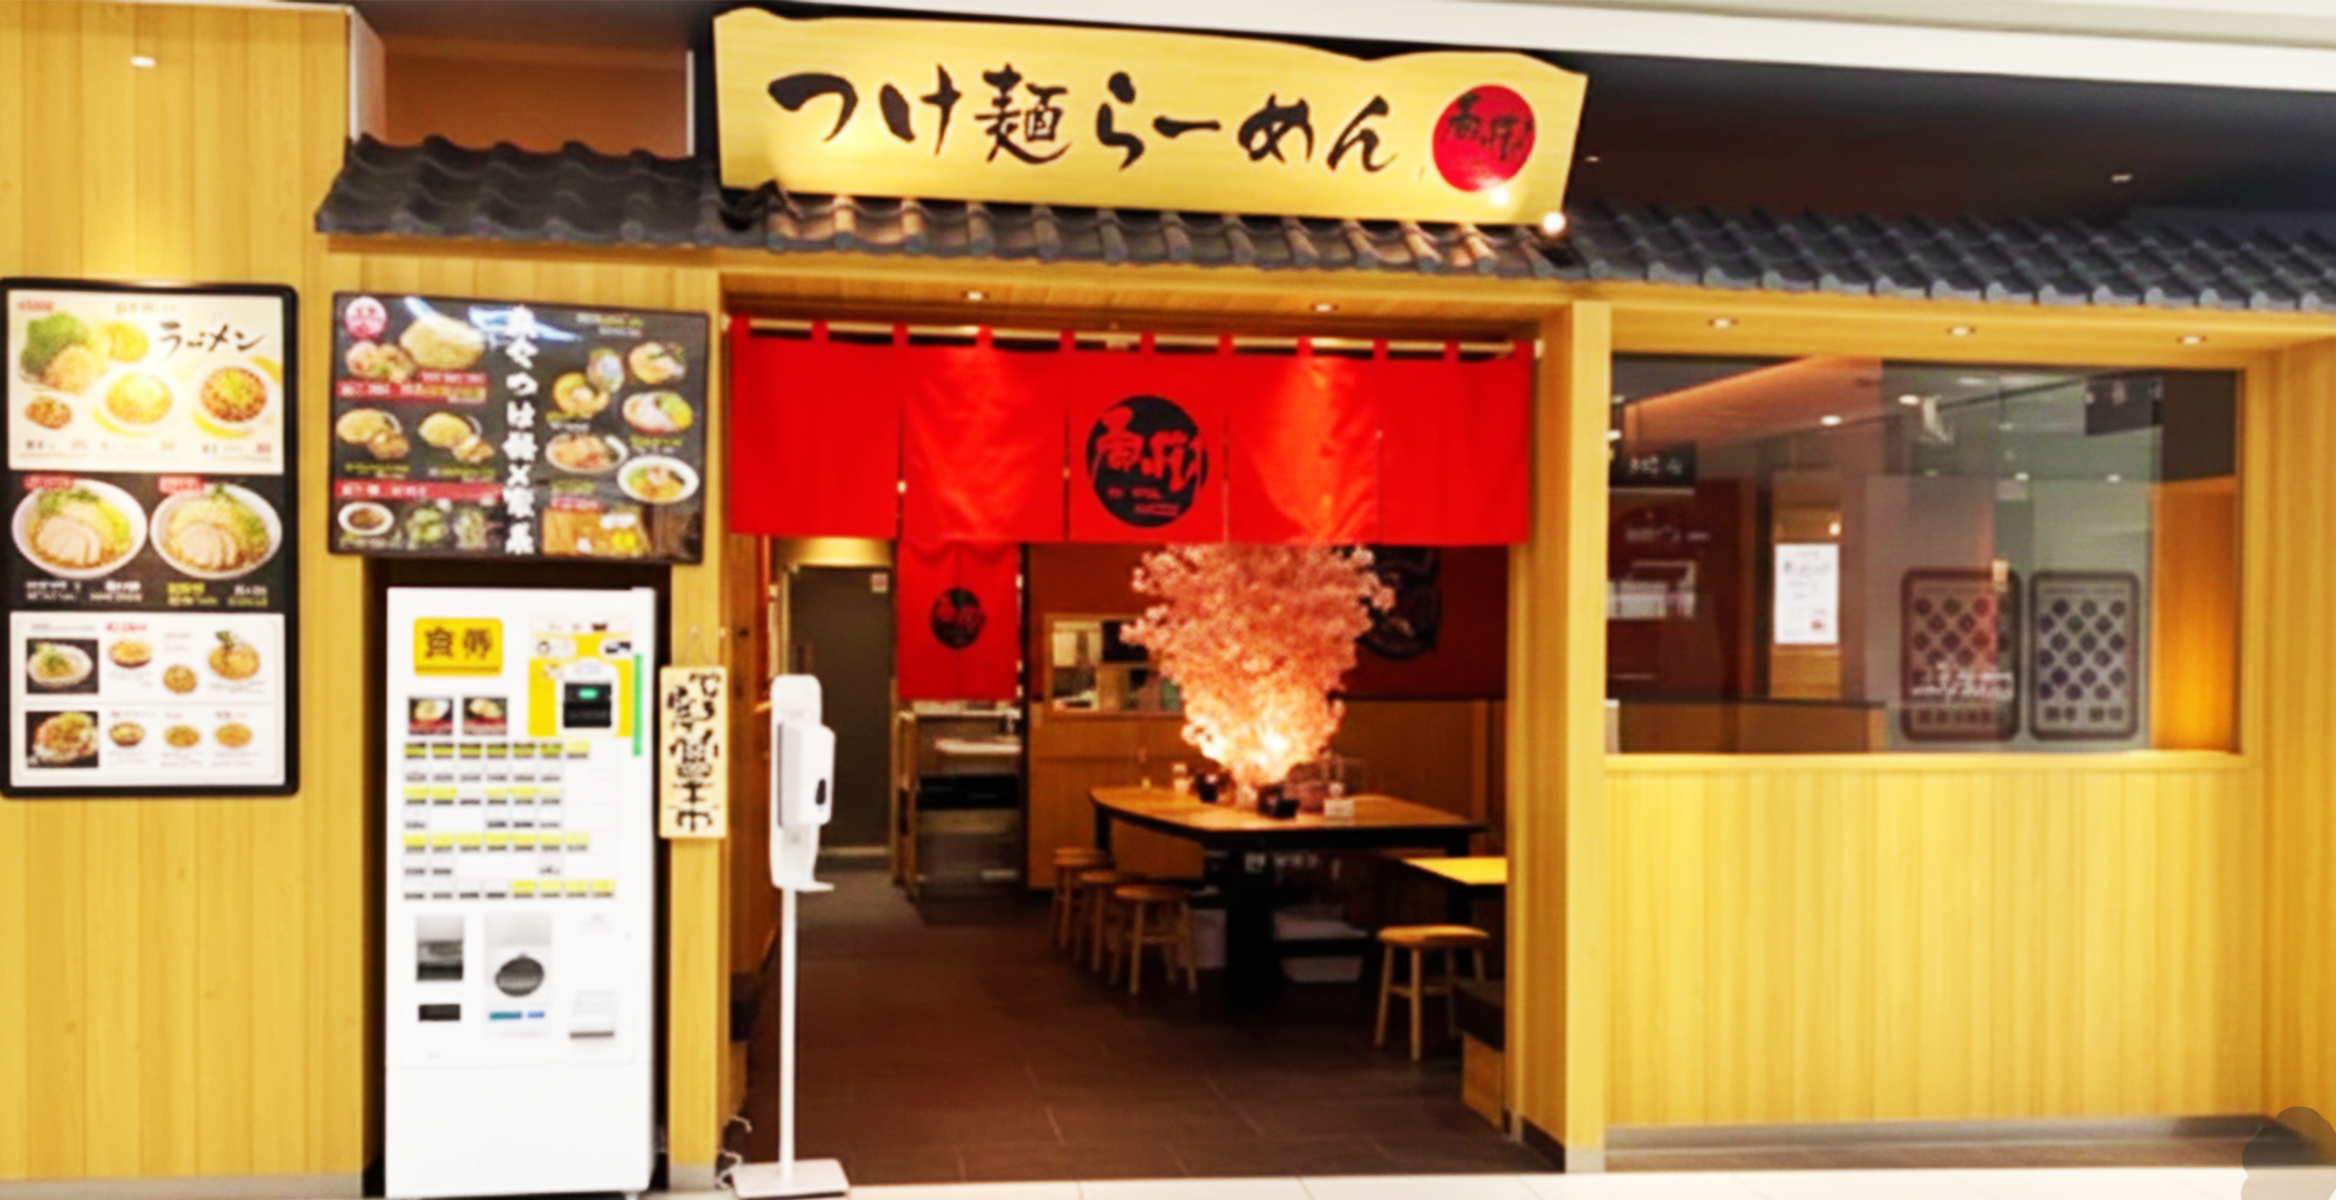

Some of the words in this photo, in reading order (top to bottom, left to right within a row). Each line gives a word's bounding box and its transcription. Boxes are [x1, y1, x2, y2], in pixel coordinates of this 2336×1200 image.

[767, 63, 1399, 173] つけ麺らーめん
